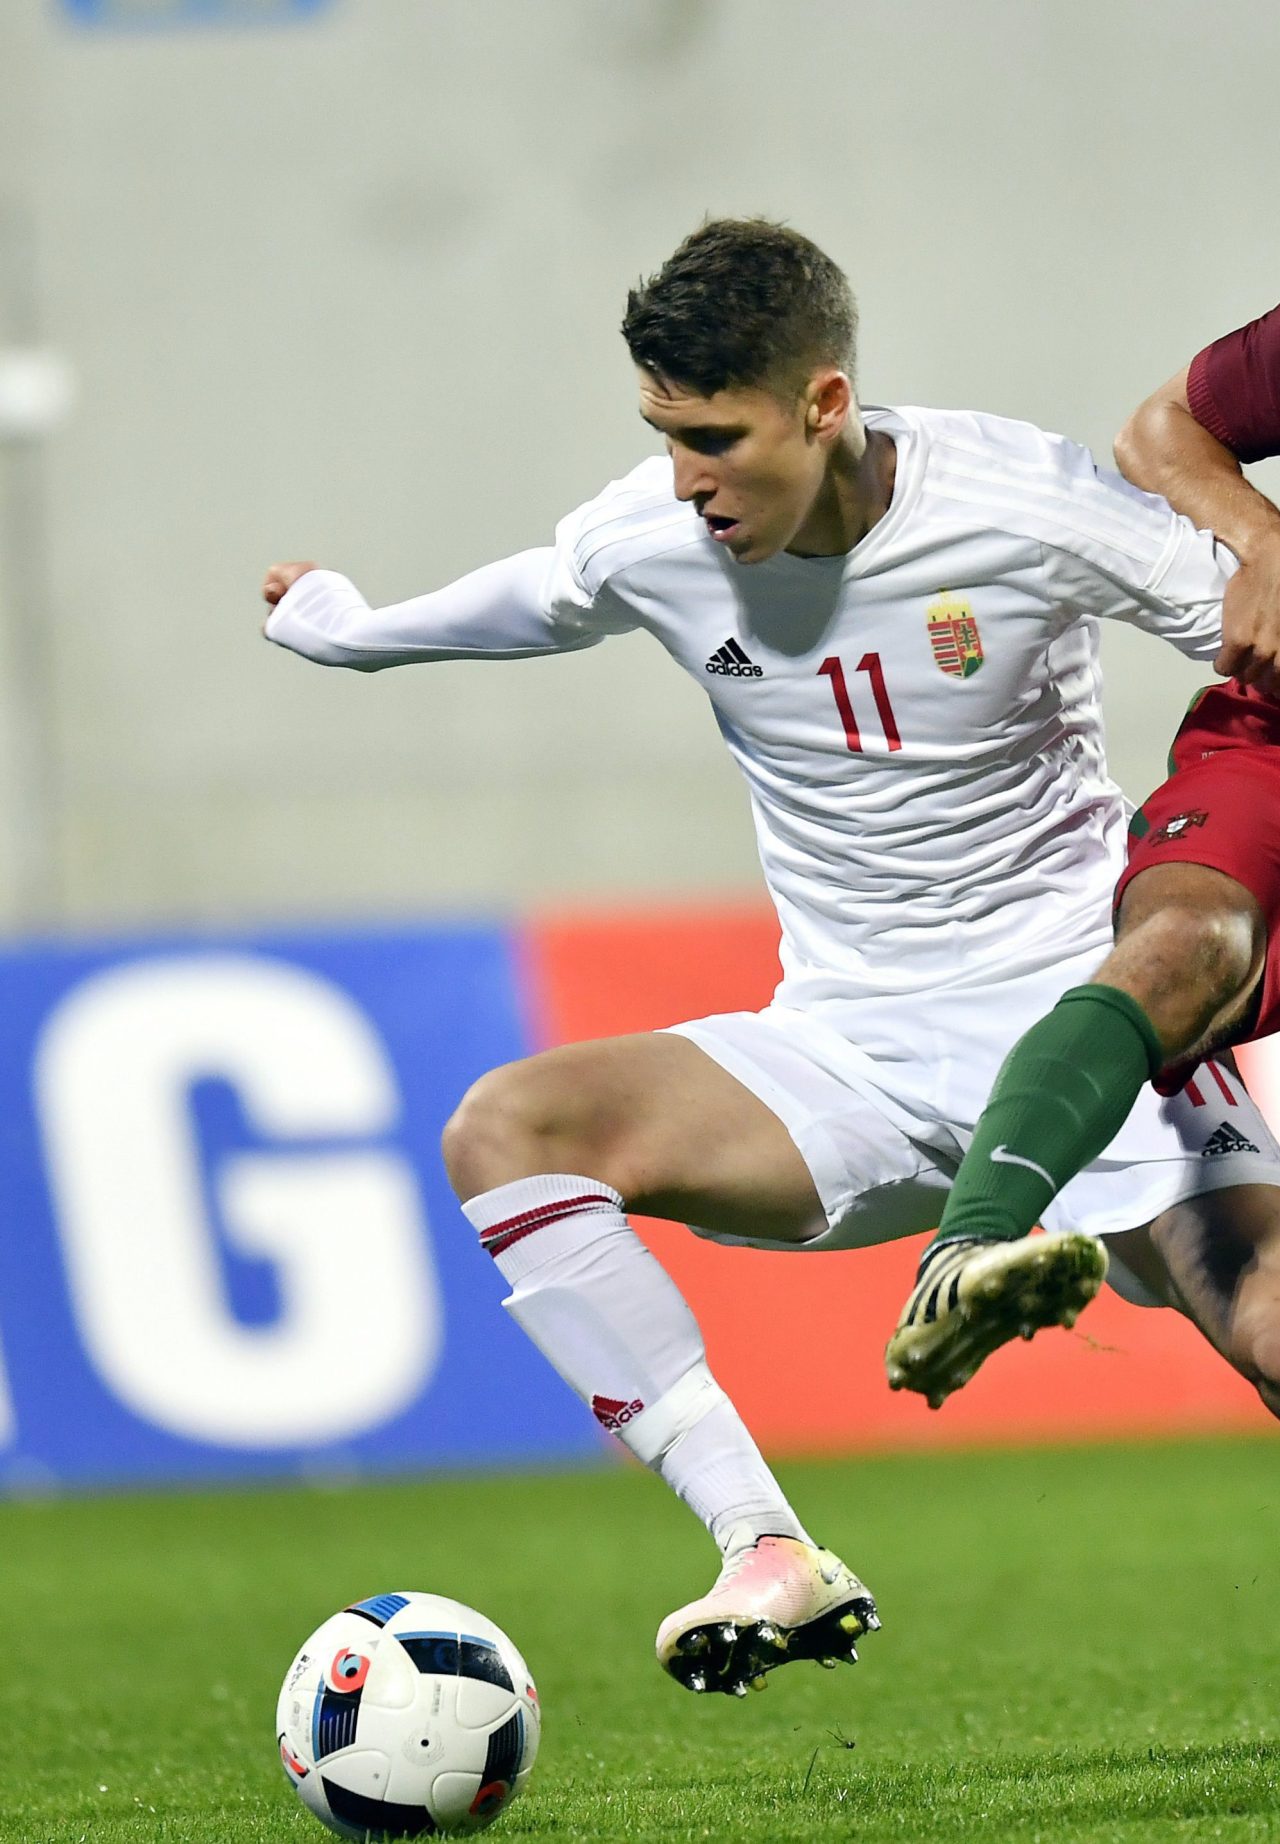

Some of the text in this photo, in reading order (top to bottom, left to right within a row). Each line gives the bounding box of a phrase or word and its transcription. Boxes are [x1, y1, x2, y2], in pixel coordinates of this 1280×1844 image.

[705, 661, 763, 678] adidas
[816, 652, 902, 753] 11
[1201, 1139, 1261, 1157] adidas
[0, 950, 446, 1450] G
